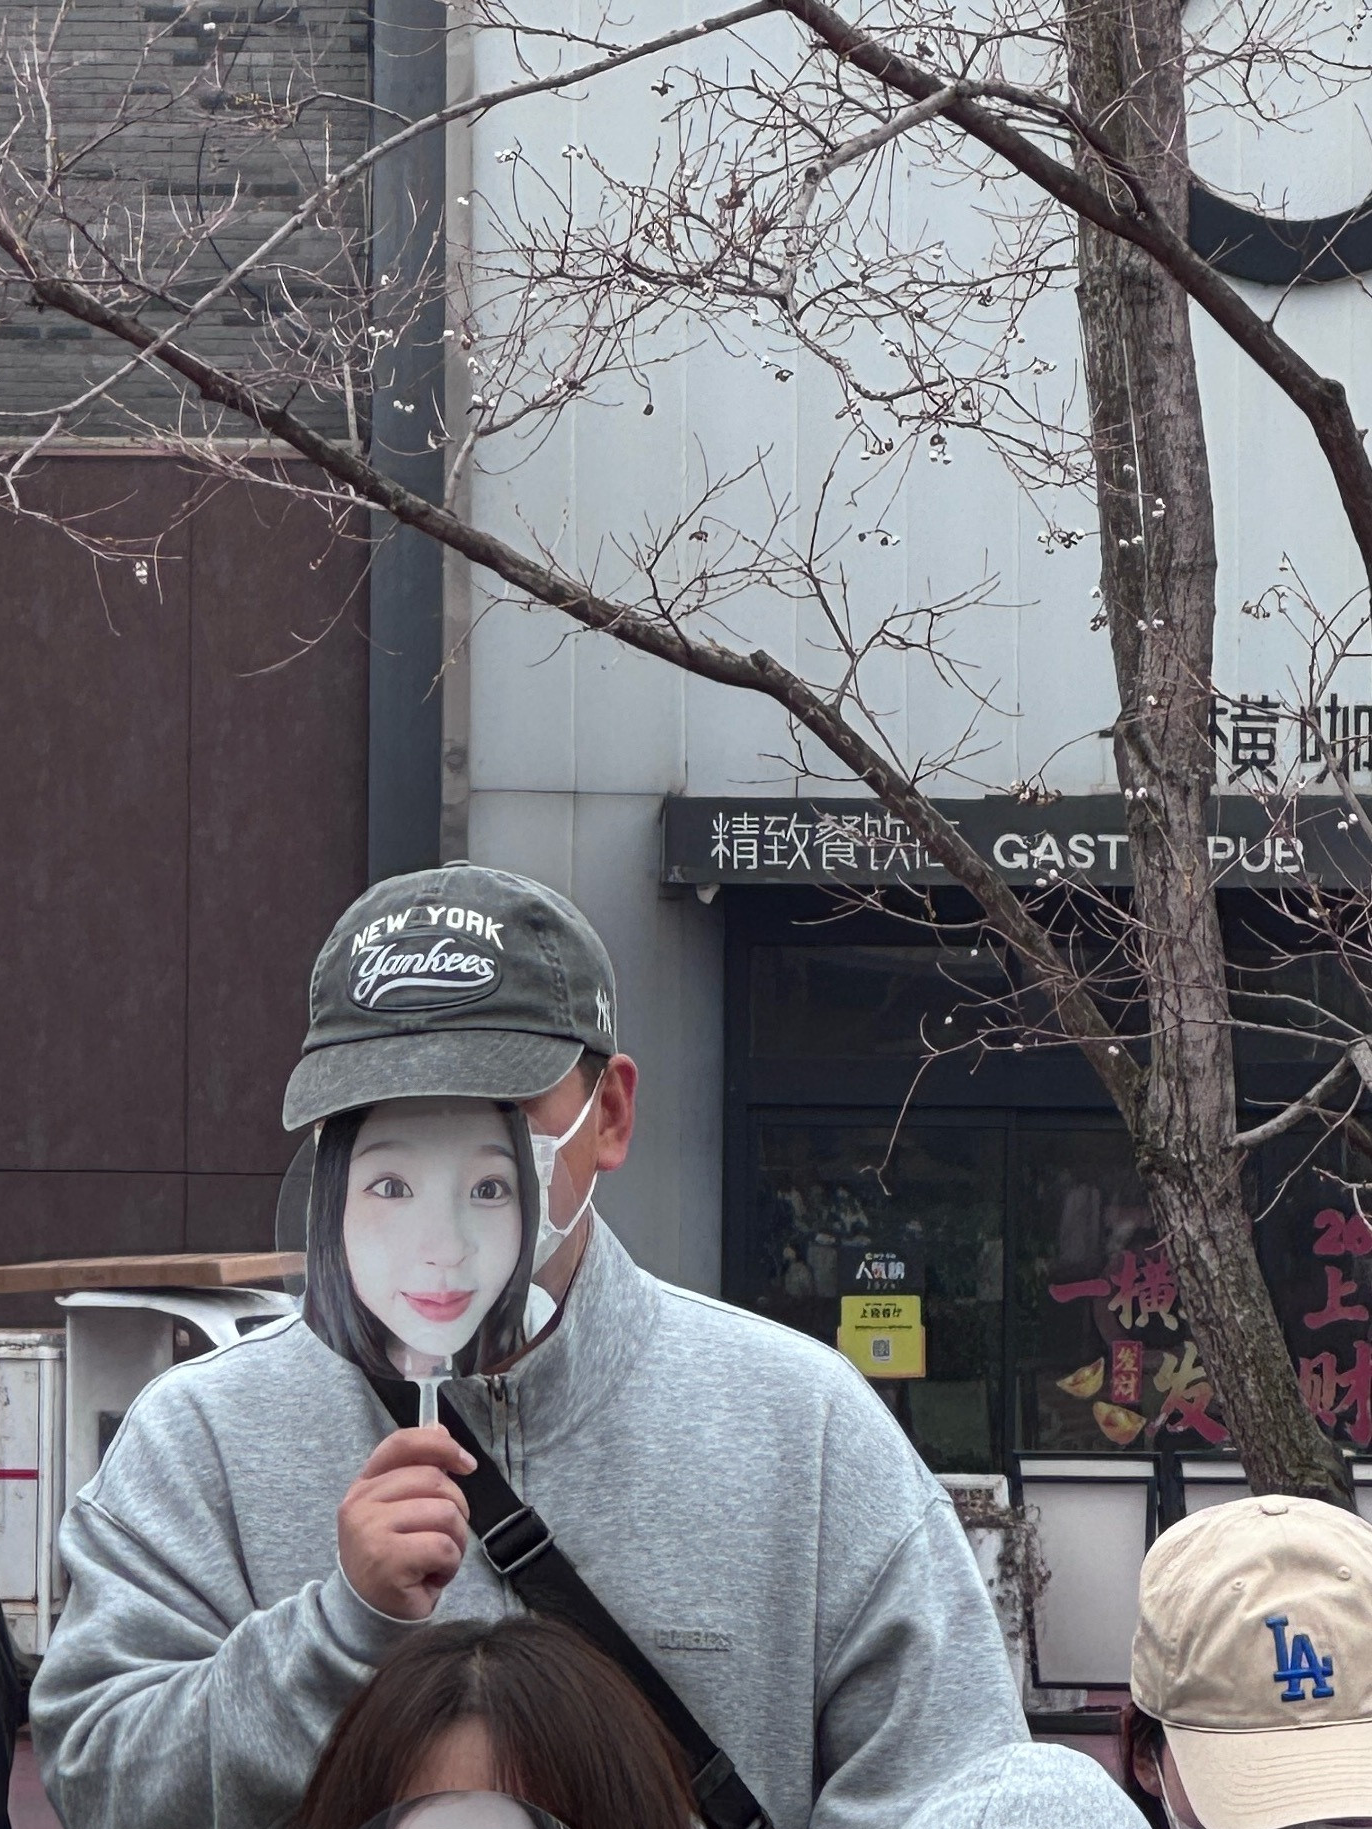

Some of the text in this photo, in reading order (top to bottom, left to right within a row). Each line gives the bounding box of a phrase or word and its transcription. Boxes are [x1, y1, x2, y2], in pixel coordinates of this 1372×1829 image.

[993, 832, 1305, 874] GASTPUB
[351, 905, 505, 956] NEW YORK
[352, 938, 497, 1006] Yankees
[1265, 1615, 1334, 1702] LA
